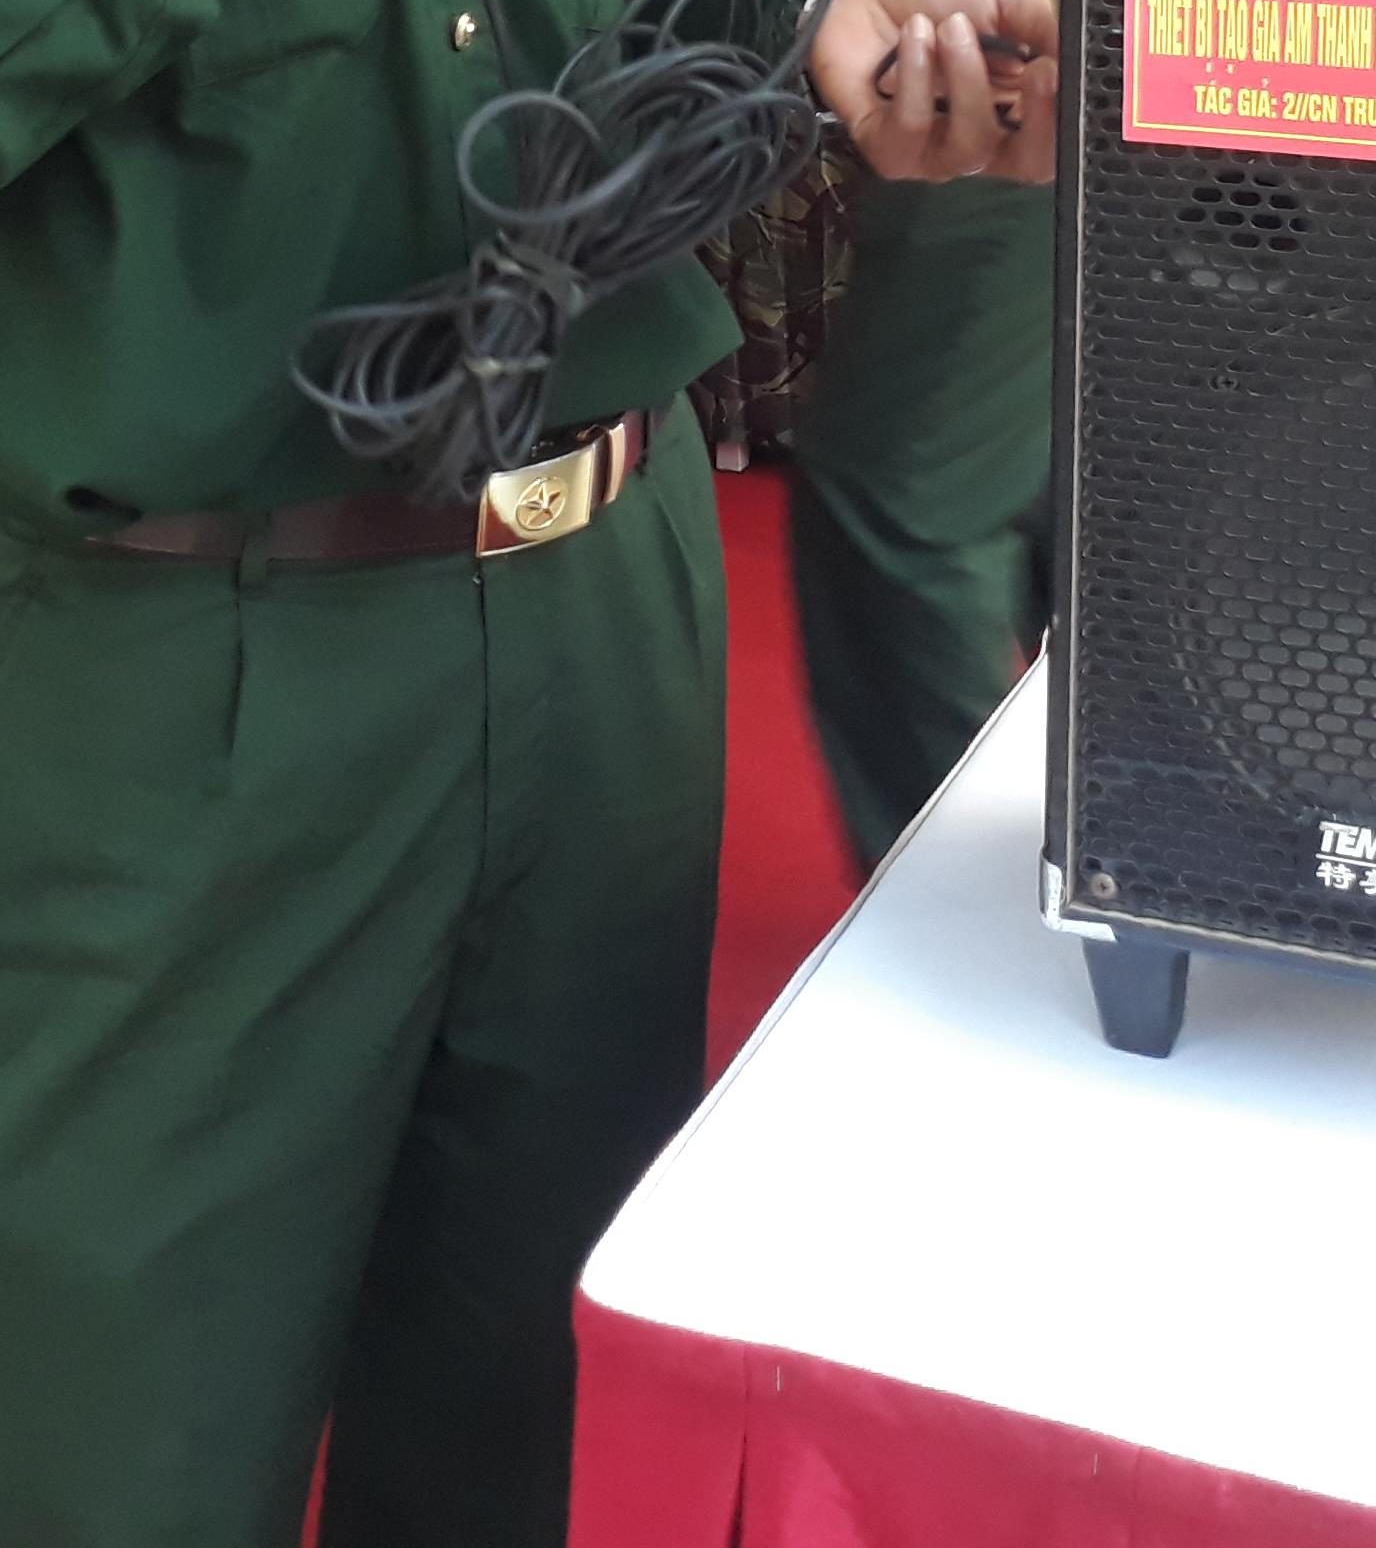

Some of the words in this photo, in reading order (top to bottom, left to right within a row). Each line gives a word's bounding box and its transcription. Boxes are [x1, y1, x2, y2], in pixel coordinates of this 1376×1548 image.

[1316, 2, 1373, 70] THANH
[1194, 79, 1232, 115] TÁC
[1237, 77, 1278, 119] GIẢ:
[1282, 91, 1338, 124] 2//CN
